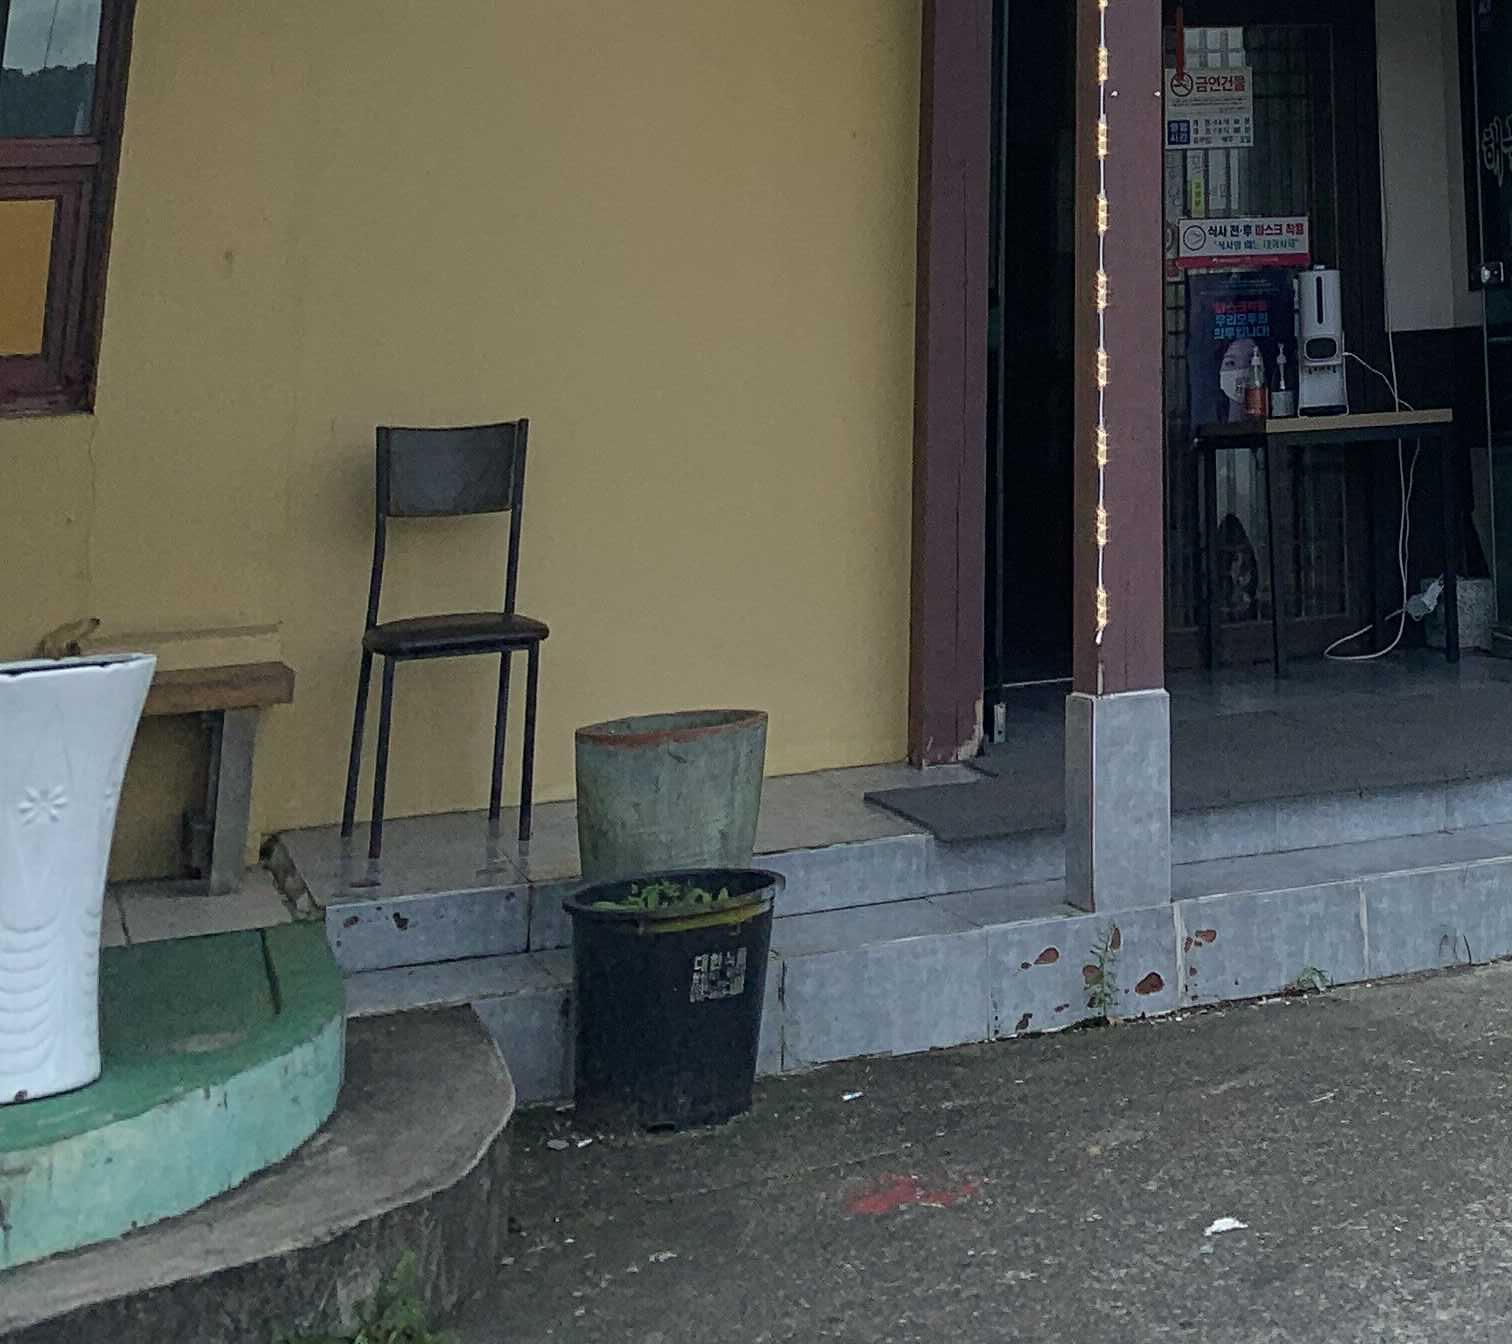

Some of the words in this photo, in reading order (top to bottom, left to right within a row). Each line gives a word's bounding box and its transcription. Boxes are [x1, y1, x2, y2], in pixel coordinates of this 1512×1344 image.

[1195, 75, 1246, 93] 금연건물
[1208, 224, 1227, 237] 식사
[1255, 223, 1283, 236] 마스크
